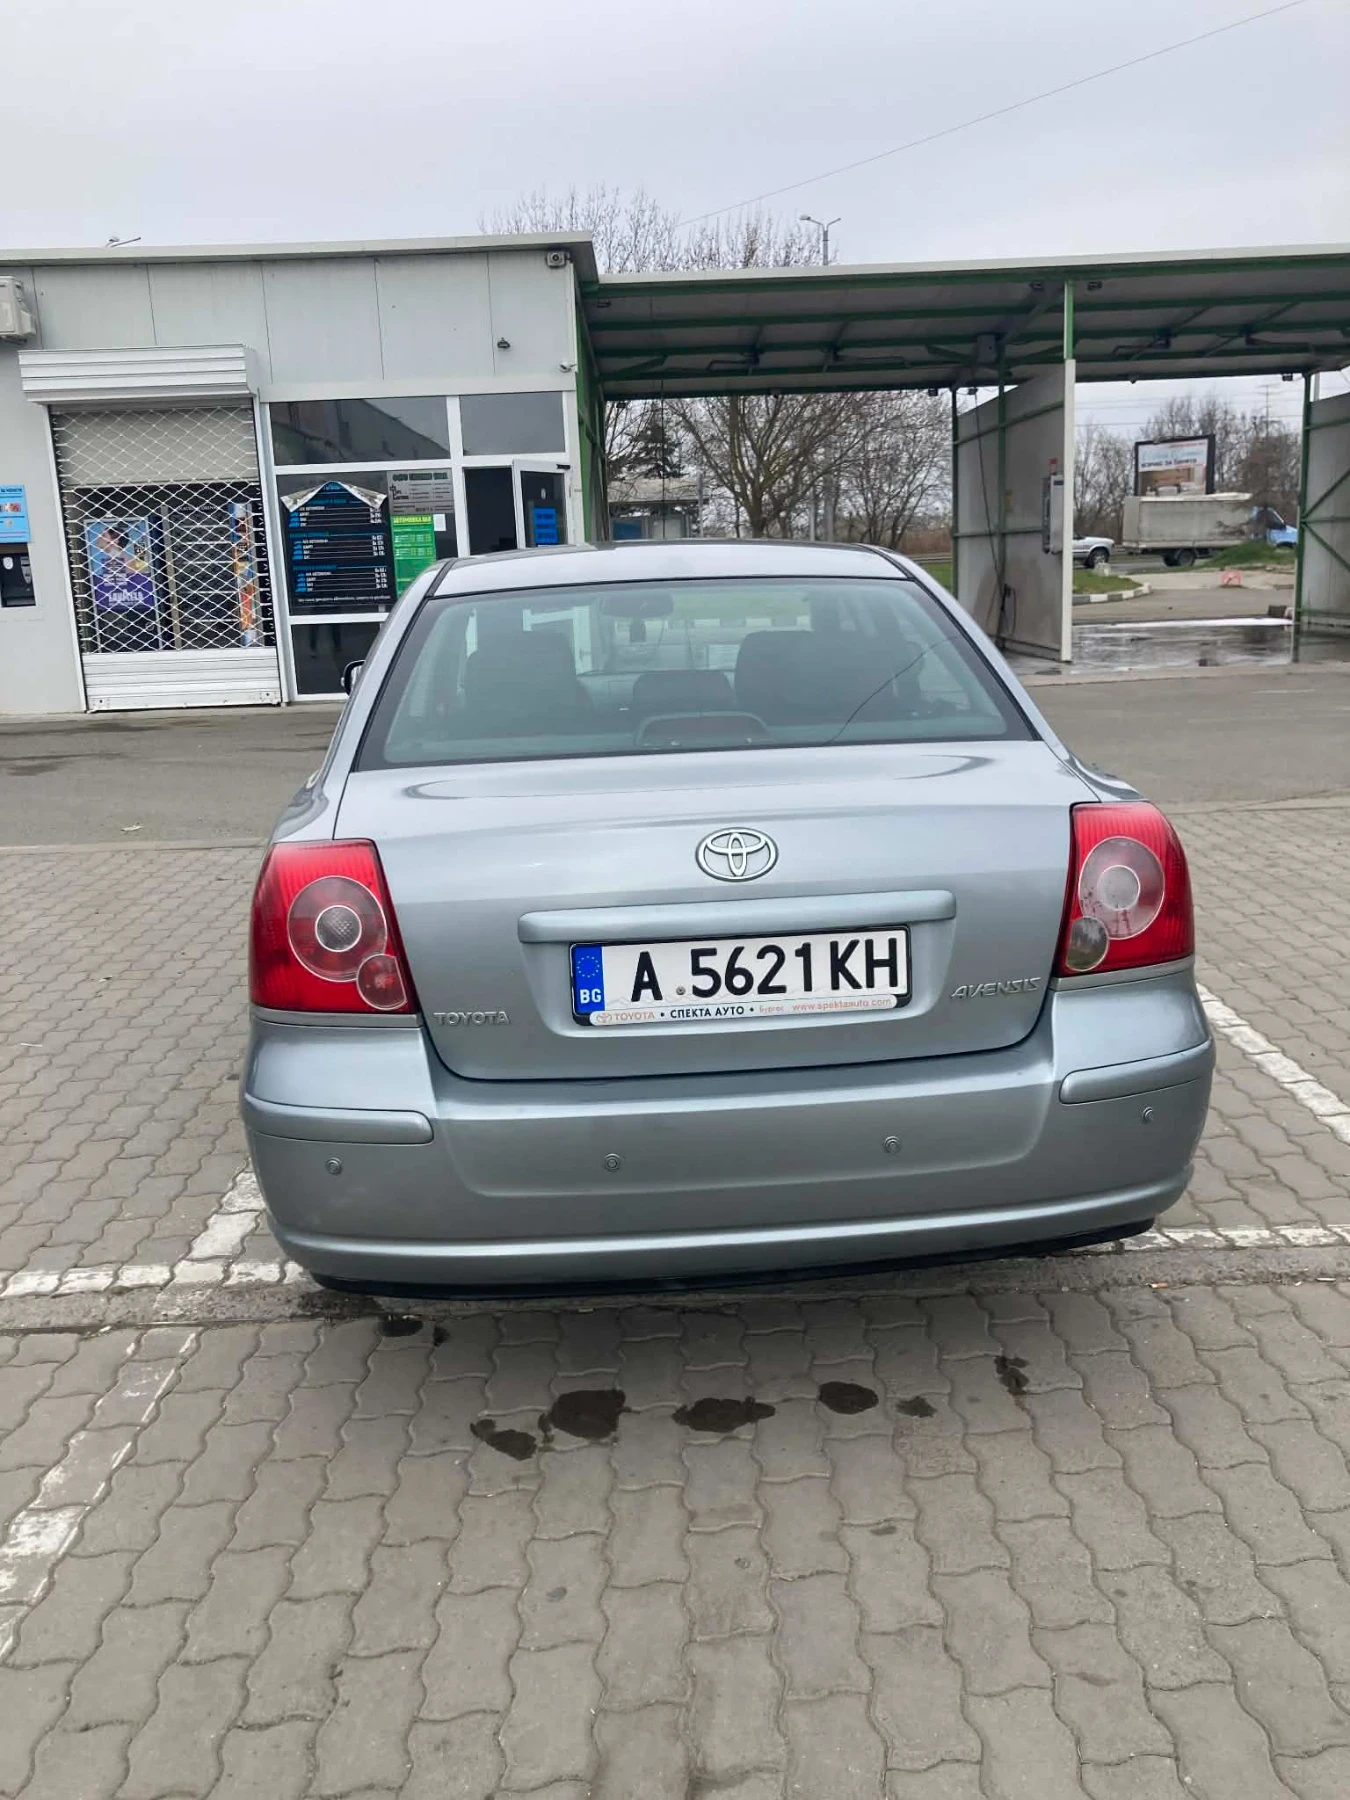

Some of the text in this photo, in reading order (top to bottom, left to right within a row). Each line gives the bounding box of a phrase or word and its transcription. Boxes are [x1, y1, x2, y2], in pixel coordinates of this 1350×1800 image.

[631, 937, 898, 1002] A 5621 KH
[580, 989, 602, 1004] BG
[951, 976, 1042, 998] AVENSIS
[433, 1011, 510, 1026] TOYOTA
[615, 1011, 655, 1021] TOYOTA
[670, 1007, 712, 1019] СПЕКТА
[715, 1005, 745, 1016] АУТО
[792, 997, 891, 1011] www.spektaauto.com
